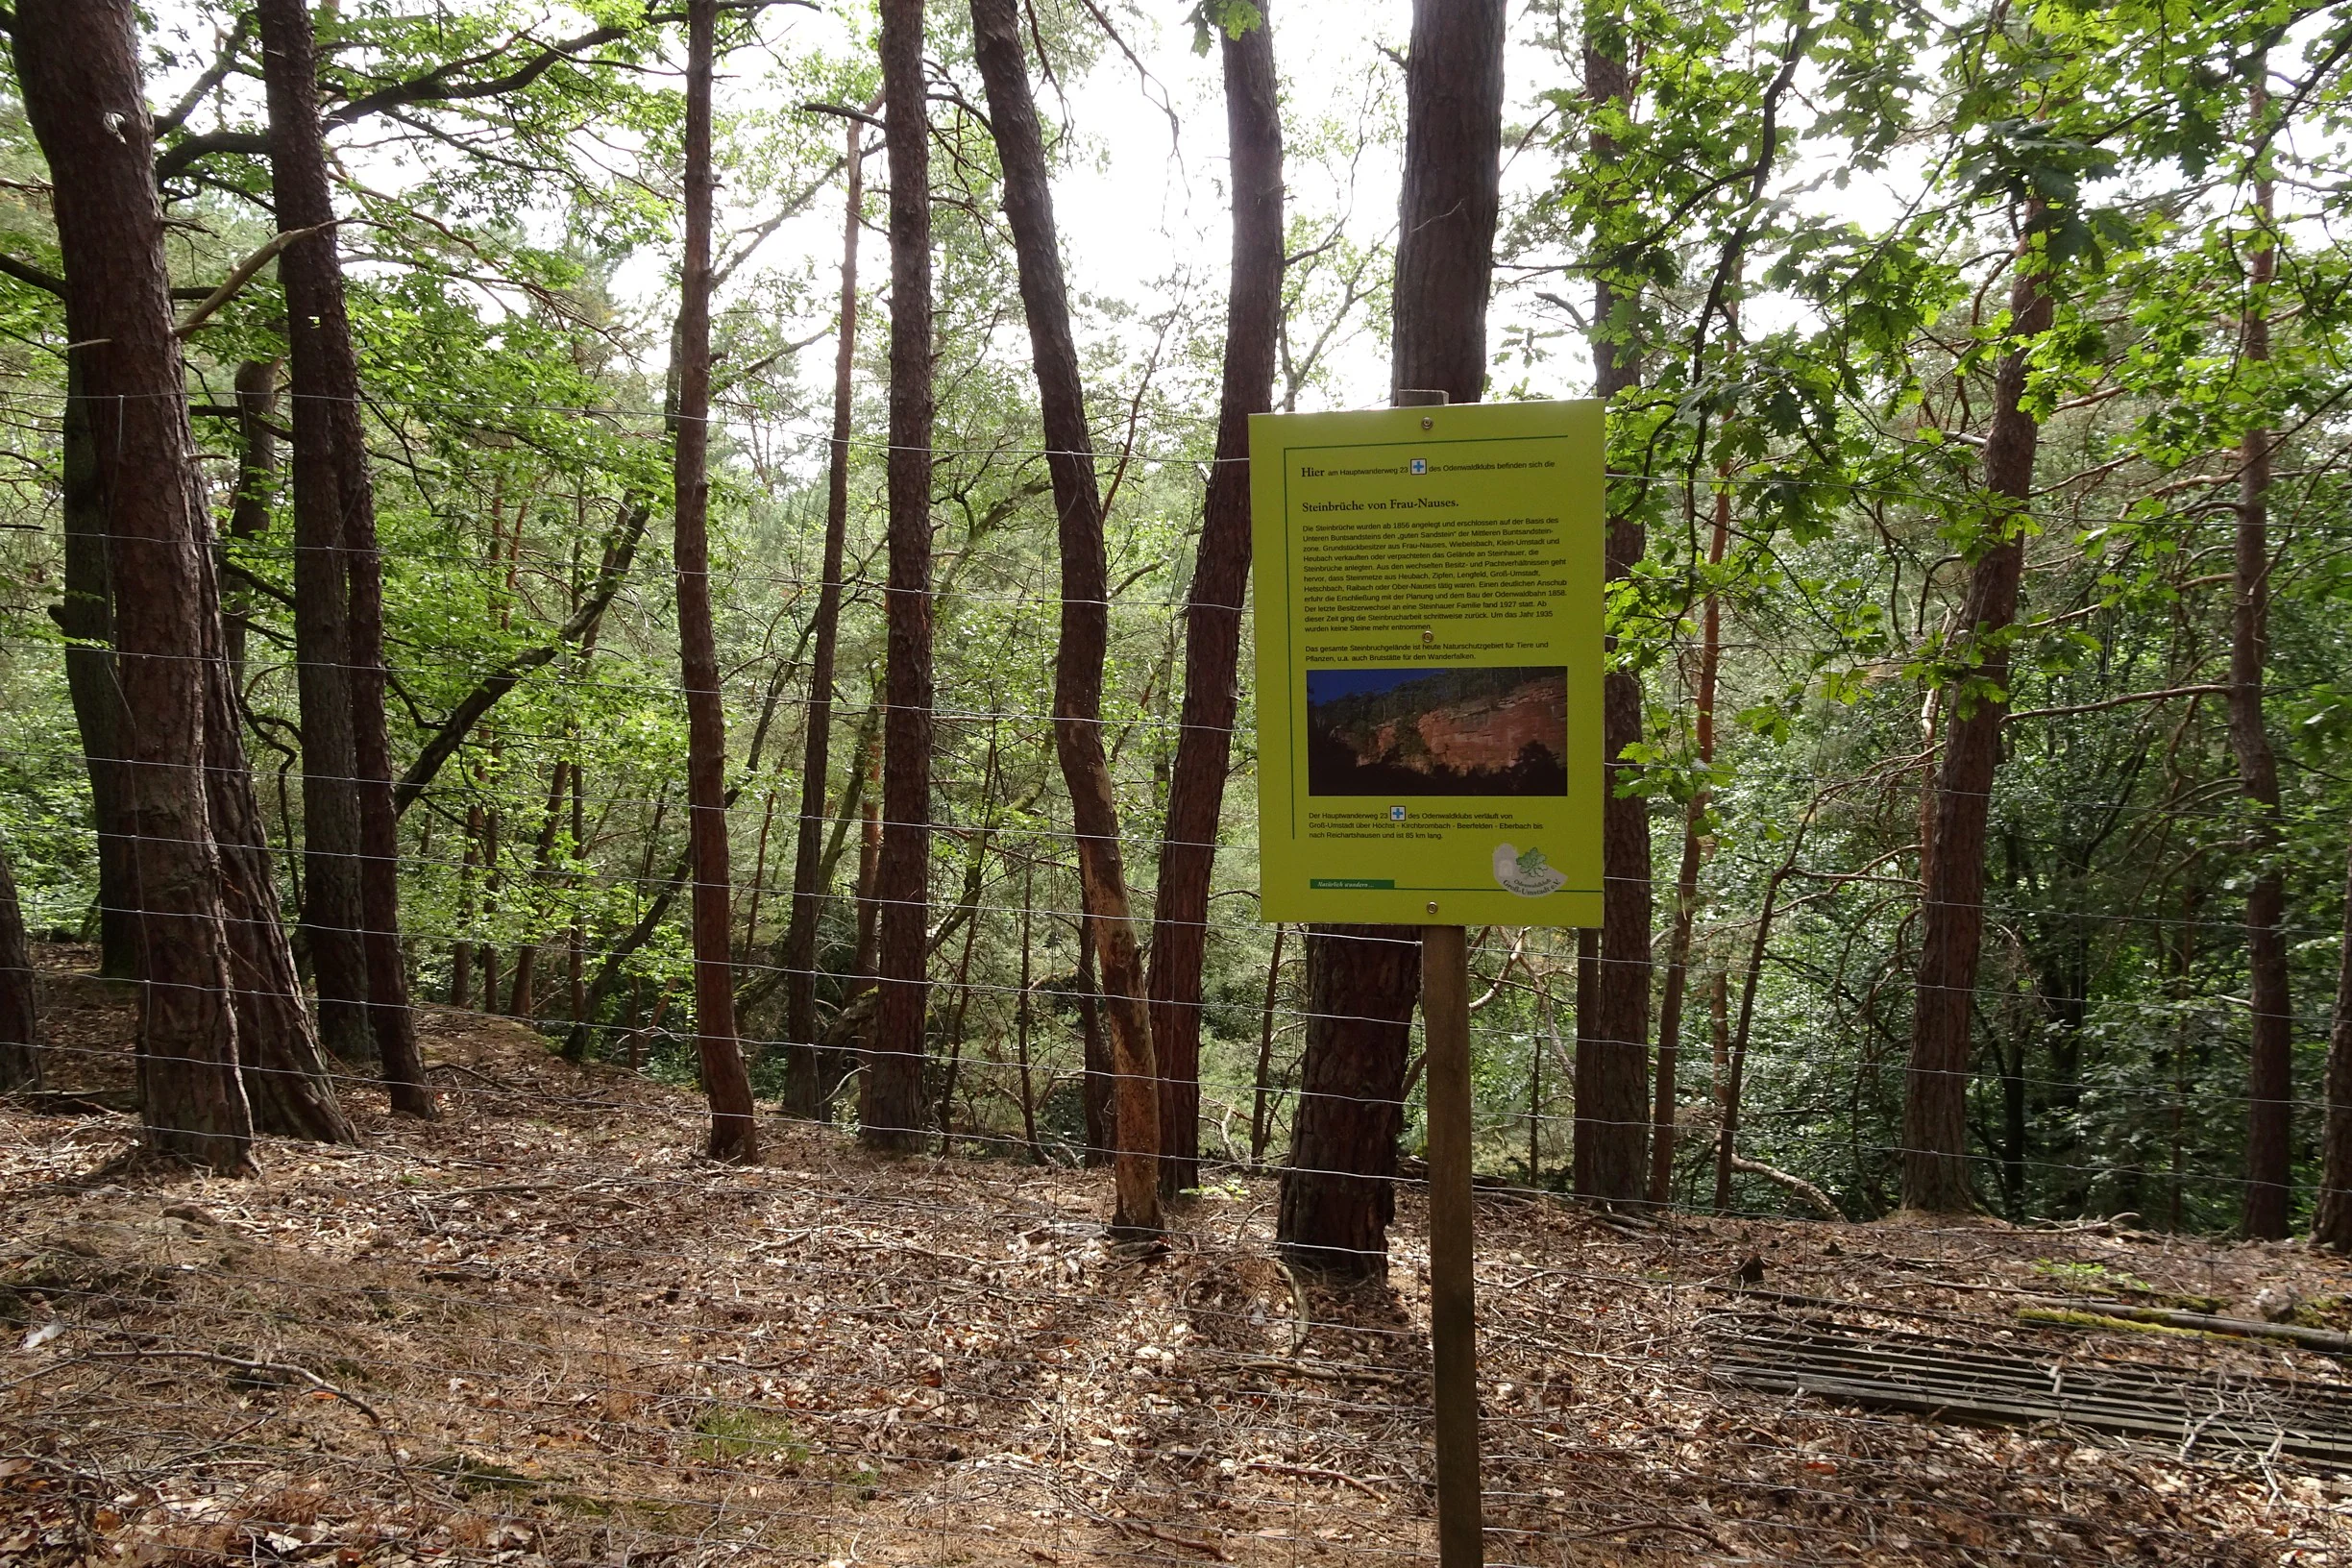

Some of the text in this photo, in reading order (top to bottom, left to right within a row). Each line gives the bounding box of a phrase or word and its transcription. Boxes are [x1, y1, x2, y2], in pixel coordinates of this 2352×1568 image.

[1301, 467, 1325, 477] Hier
[1340, 467, 1398, 476] Hauptwanderweg
[1302, 501, 1364, 512] Steinbrüche
[1390, 498, 1459, 509] Frau-Nauses.
[1316, 523, 1355, 532] Steinbrüche
[1411, 520, 1441, 530] angelegt
[1456, 519, 1497, 527] erschlossen
[1331, 532, 1381, 541] Buntsandsteins
[1503, 527, 1553, 536] Buntsandstein-
[1323, 542, 1386, 551] Grundstückbesitzer
[1449, 539, 1494, 549] Wiebelsbach,
[1497, 538, 1545, 546] Klein-Umstadt
[1334, 553, 1368, 561] verkauften
[1387, 551, 1430, 561] verpachteten
[1487, 549, 1526, 558] Steinhauer,
[1303, 564, 1343, 572] Steinbrüche
[1344, 563, 1374, 573] anlegten.
[1405, 561, 1443, 569] wechselten
[1485, 558, 1549, 567] Pachtverhältnissen
[1551, 558, 1566, 567] geht
[1304, 574, 1327, 583] hervor,
[1398, 572, 1430, 580] Heubach,
[1457, 570, 1488, 580] Lengfeld,
[1490, 569, 1541, 578] Groß-Umstadt,
[1304, 584, 1344, 593] Hetschbach,
[1392, 582, 1436, 590] Ober-Nauses
[1438, 581, 1452, 590] tätig
[1337, 593, 1379, 603] Erschließung
[1406, 592, 1433, 601] Planung
[1495, 589, 1546, 598] Odenwaldbahn
[1337, 603, 1391, 611] Besitzerwechsel
[1340, 614, 1355, 623] ging
[1368, 612, 1422, 621] Steinbrucharbeit
[1320, 645, 1348, 653] gesamte
[1350, 643, 1411, 653] Steinbruchgelände
[1443, 641, 1504, 651] Naturschutzgebiet
[1305, 654, 1336, 663] Pflanzen,
[1322, 812, 1378, 821] Hauptwanderweg
[1427, 831, 1443, 840] lang.
[1503, 880, 1550, 895] Groß-Umstadt
